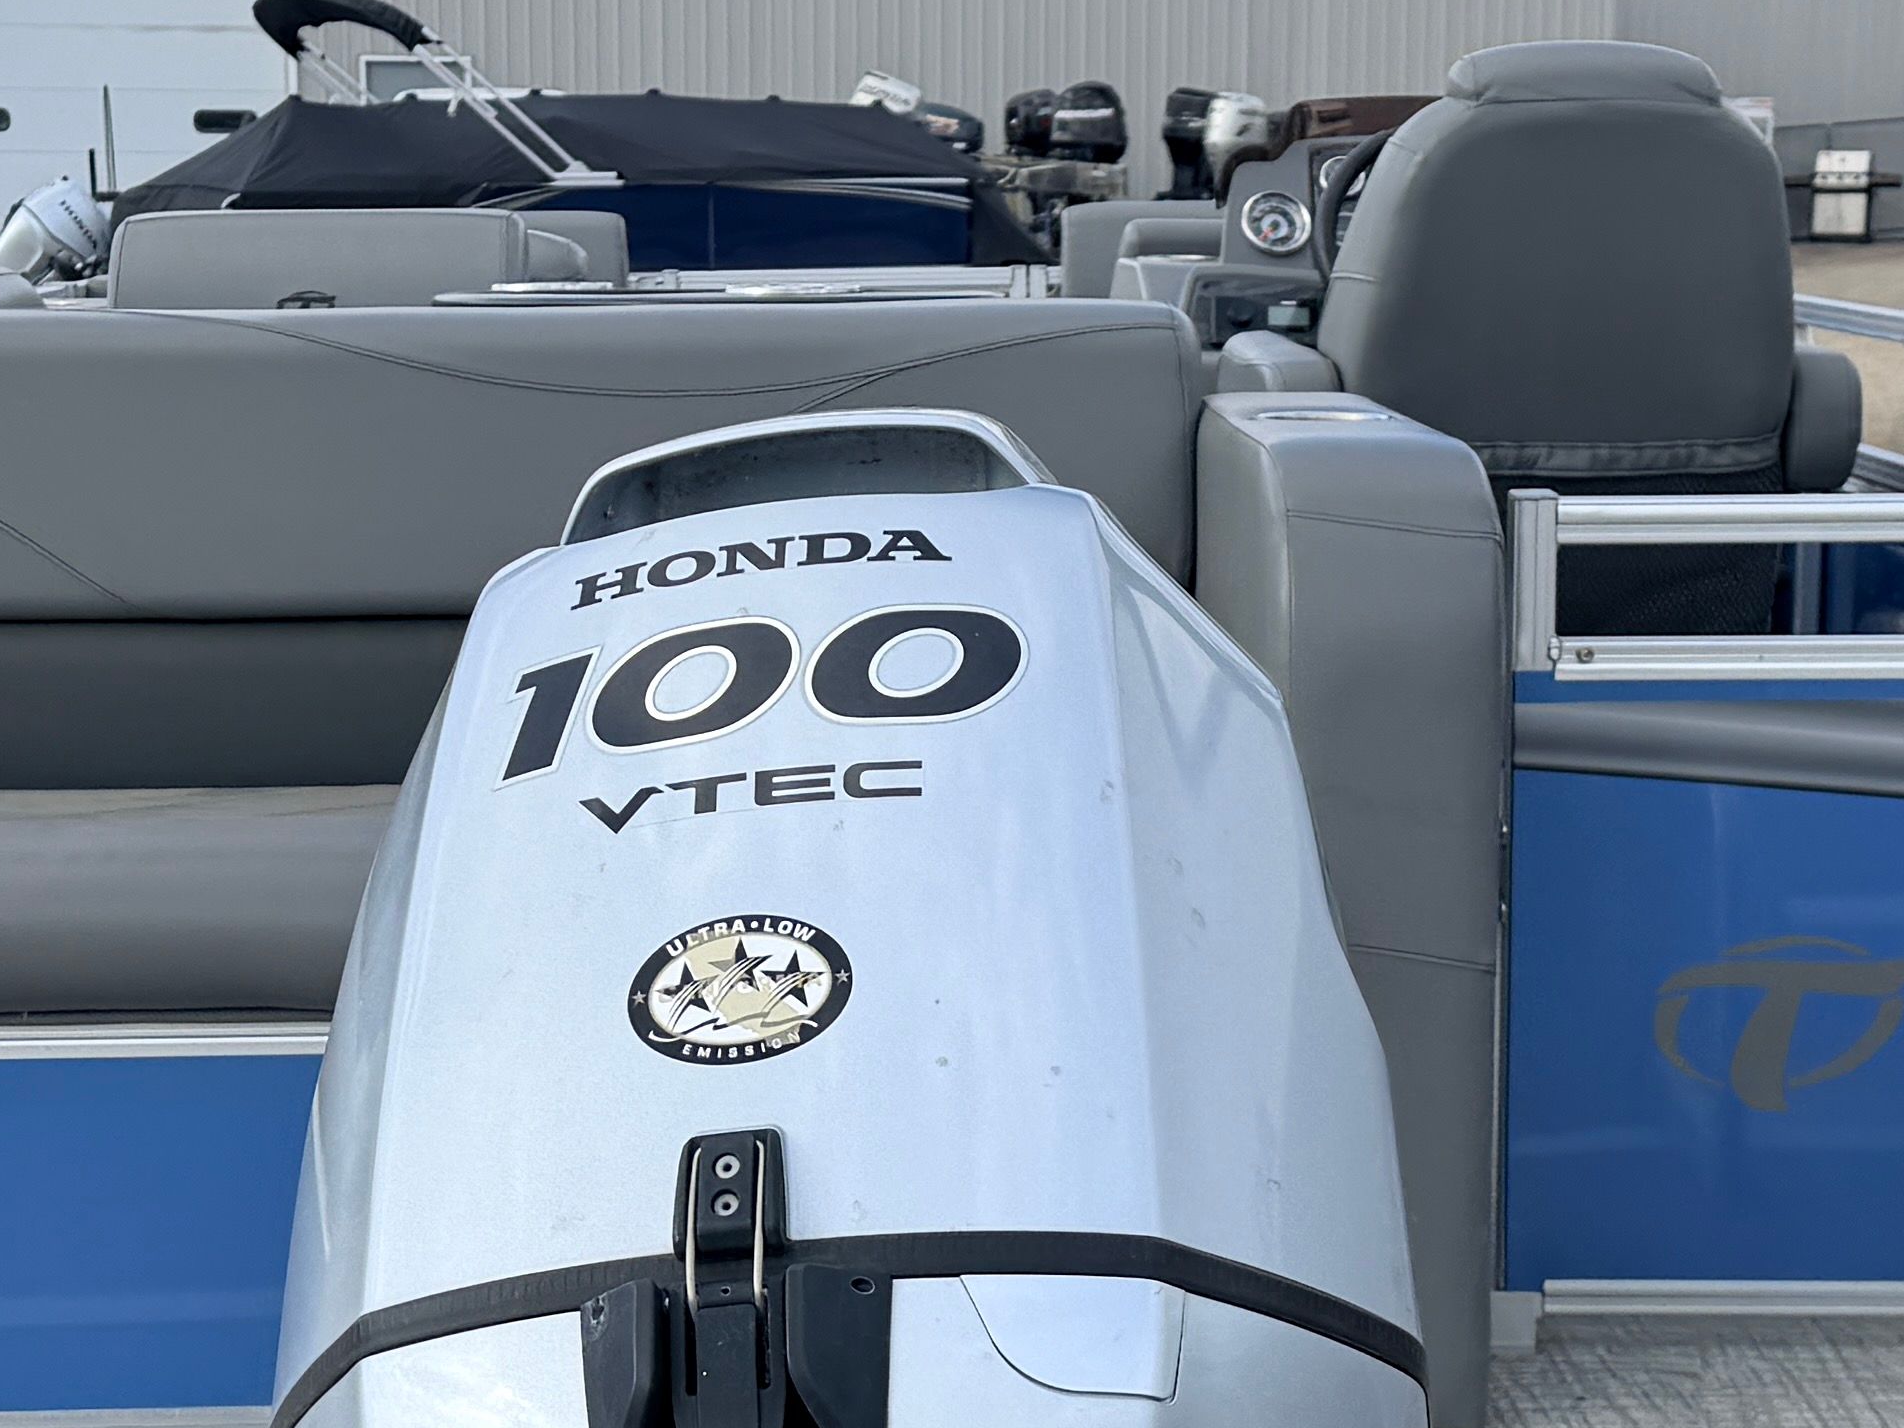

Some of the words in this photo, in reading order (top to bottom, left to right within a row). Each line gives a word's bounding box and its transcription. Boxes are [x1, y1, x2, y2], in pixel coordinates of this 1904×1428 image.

[569, 529, 953, 611] HONDA
[498, 604, 1028, 787] 100
[578, 759, 924, 835] VTEC
[681, 1030, 802, 1060] EMISSION
